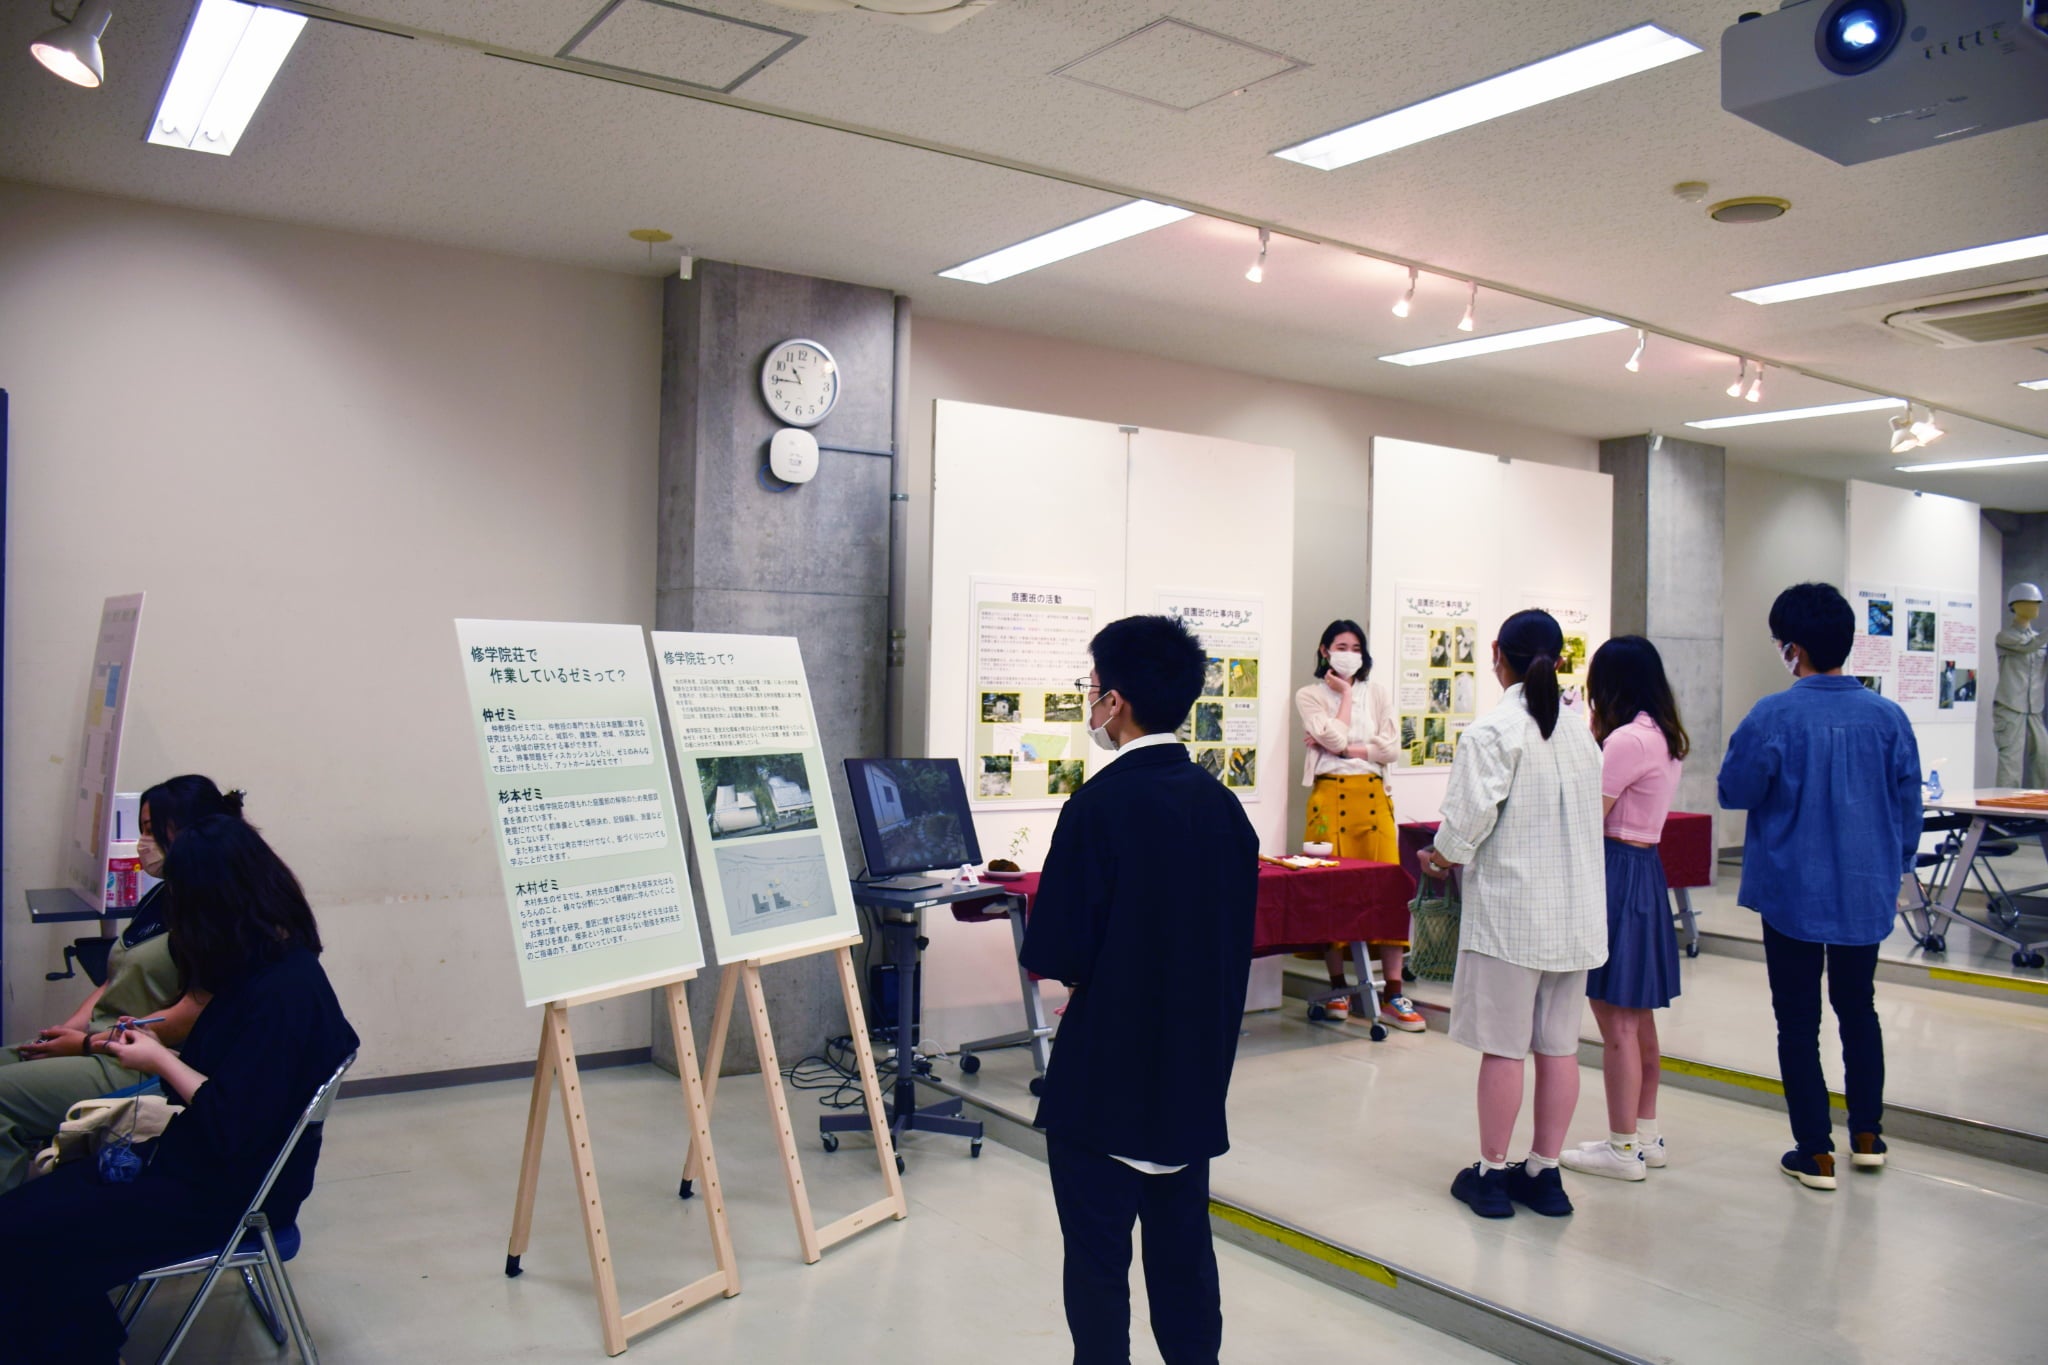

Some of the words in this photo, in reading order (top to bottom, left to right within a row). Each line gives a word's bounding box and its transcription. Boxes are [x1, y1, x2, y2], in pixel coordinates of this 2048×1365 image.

[1011, 592, 1062, 604] 庭園班の活動
[1183, 607, 1241, 619] 庭園班の仕事内容
[470, 645, 538, 664] 修学院荘で
[663, 651, 735, 666] 修学院荘って？
[489, 667, 626, 685] 作業しているゼミって？
[482, 707, 517, 723] 仲ゼミ
[498, 788, 543, 804] 杉本ゼミ
[515, 879, 560, 897] 木村ゼミ
